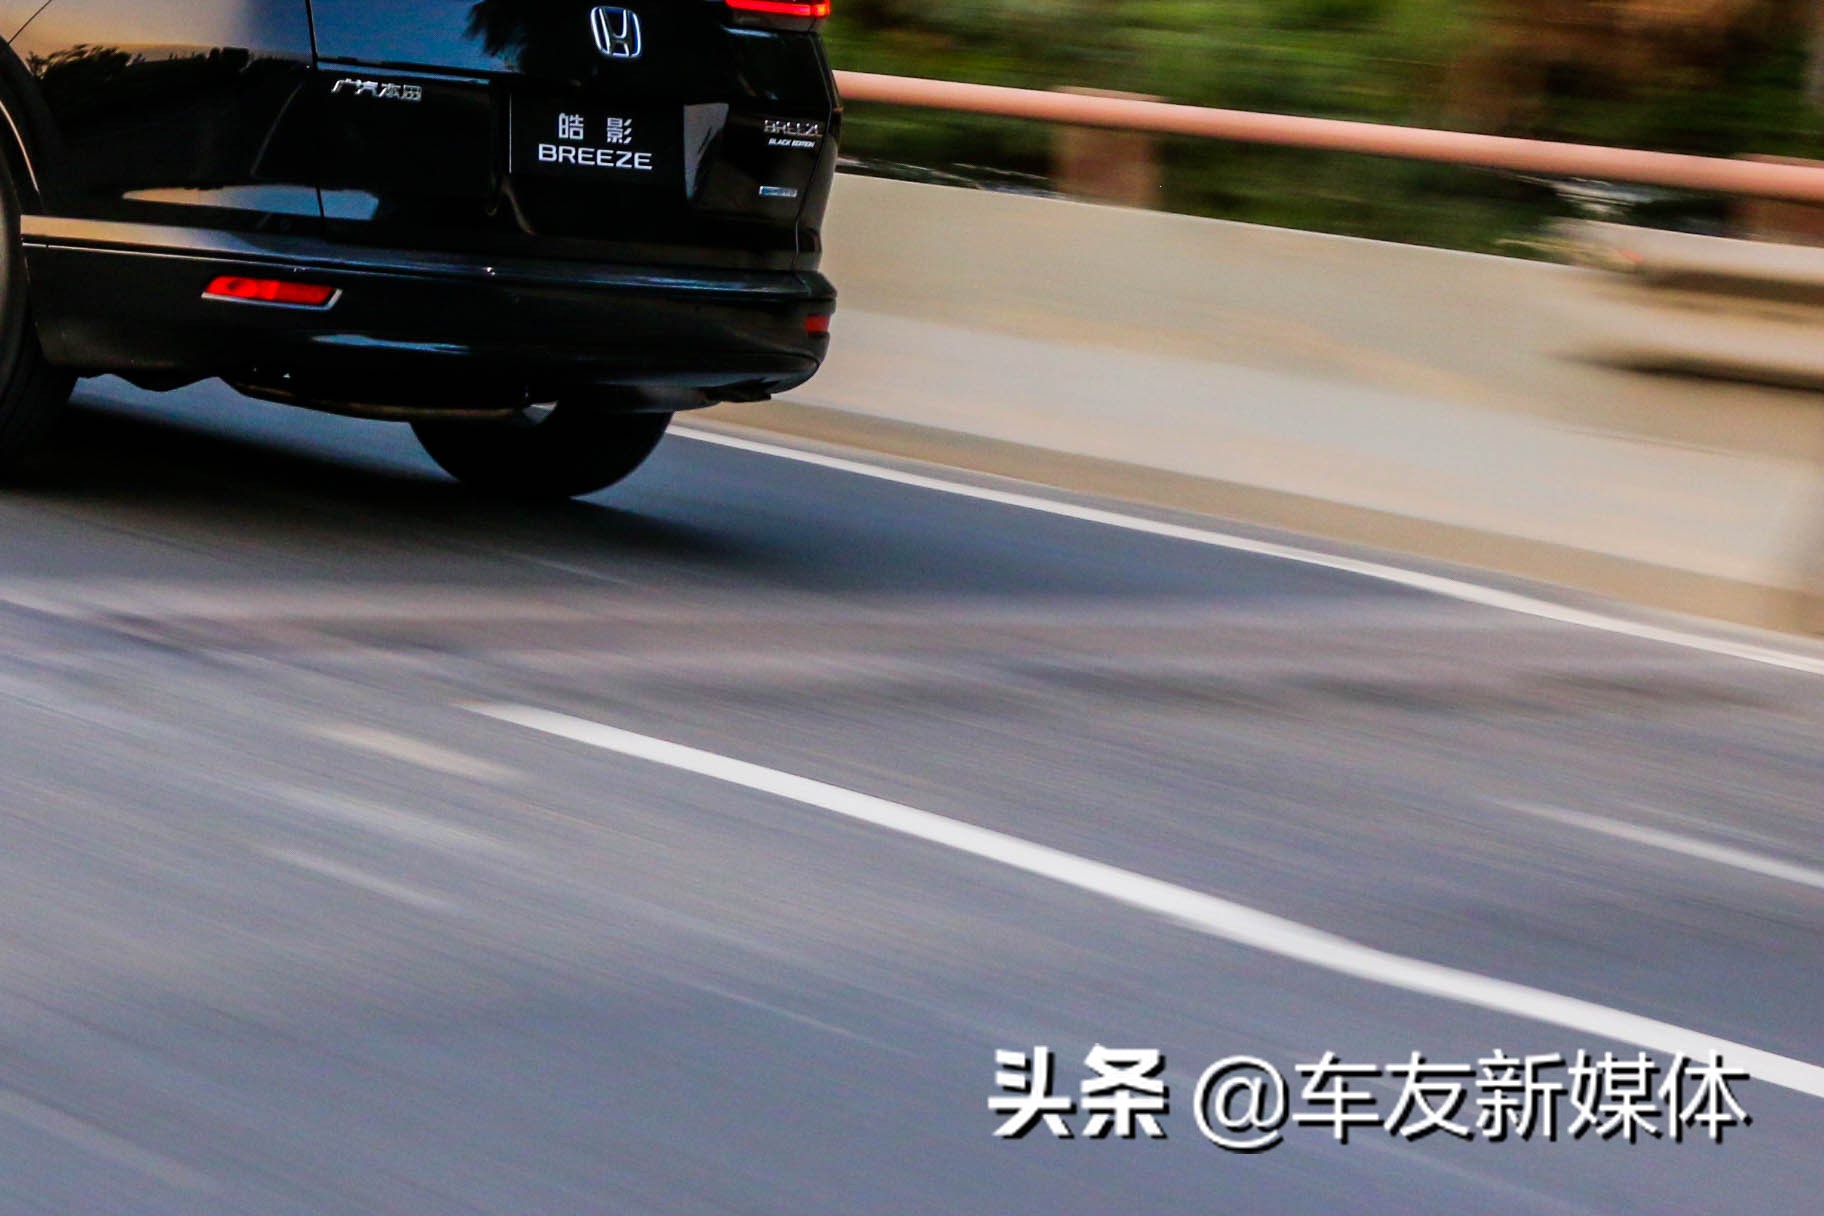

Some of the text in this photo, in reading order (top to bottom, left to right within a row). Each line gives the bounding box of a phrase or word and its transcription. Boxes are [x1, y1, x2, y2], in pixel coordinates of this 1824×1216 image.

[558, 112, 632, 144] 皓影
[768, 138, 792, 146] BLACK
[538, 143, 653, 170] BREEZE
